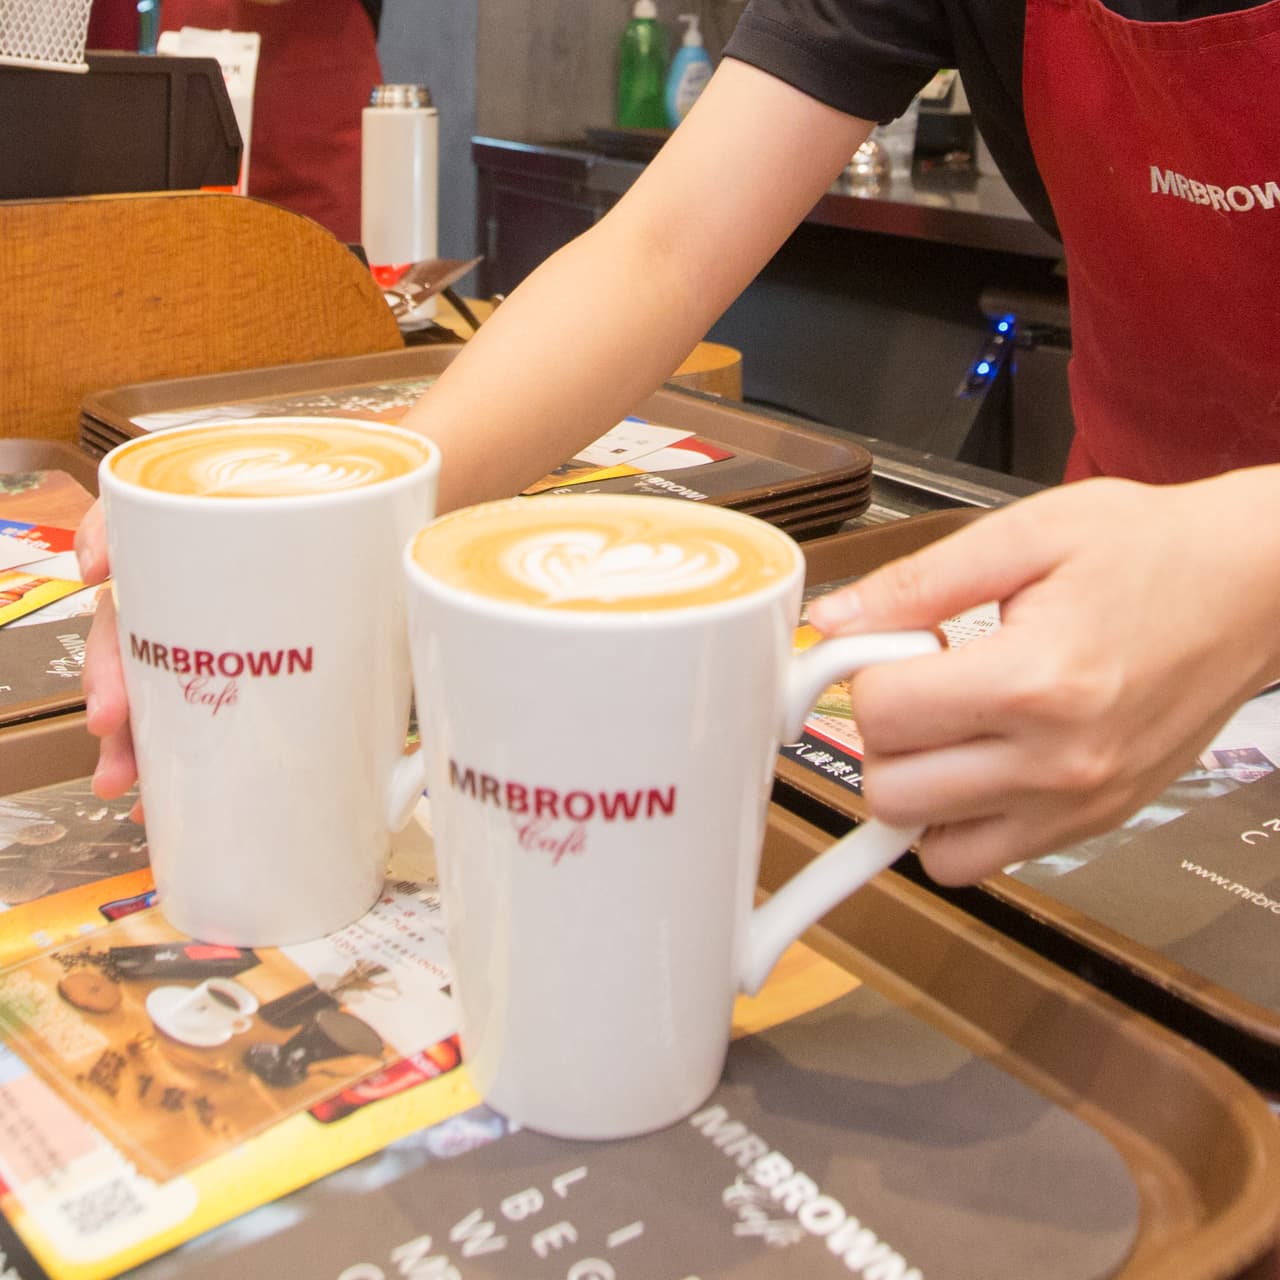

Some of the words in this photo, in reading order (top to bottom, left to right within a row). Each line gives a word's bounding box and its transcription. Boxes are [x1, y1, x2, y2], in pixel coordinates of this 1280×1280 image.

[130, 632, 313, 677] MRBROWN
[178, 675, 240, 717] Café
[449, 757, 676, 821] MRBROWN
[512, 818, 587, 868] Café
